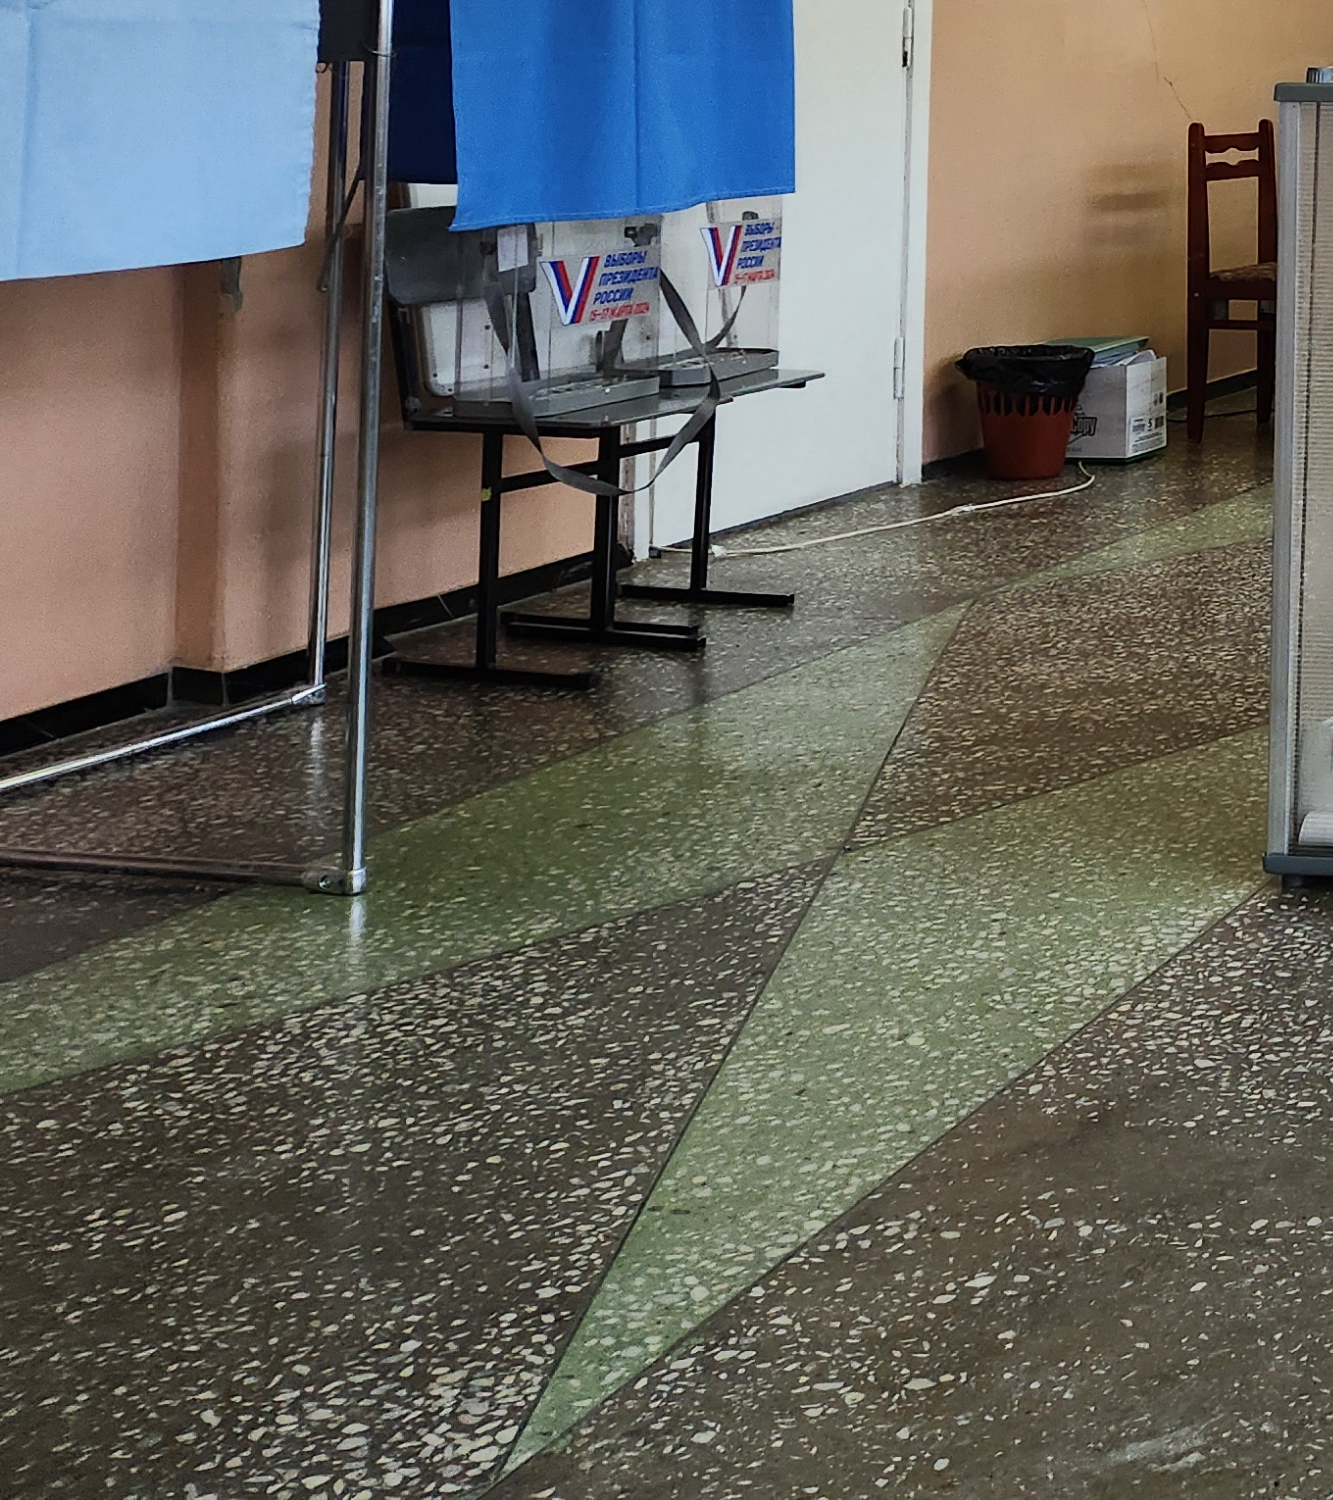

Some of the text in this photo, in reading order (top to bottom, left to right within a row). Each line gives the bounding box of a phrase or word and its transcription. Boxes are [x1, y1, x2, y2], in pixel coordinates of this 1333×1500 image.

[744, 222, 774, 236] ВЫБОРЫ
[604, 250, 648, 268] ВЫБОРЫ
[736, 255, 764, 269] РОССИИ
[598, 266, 659, 287] ПРЕЗИДЕНТА
[593, 287, 634, 305] РОССИИ
